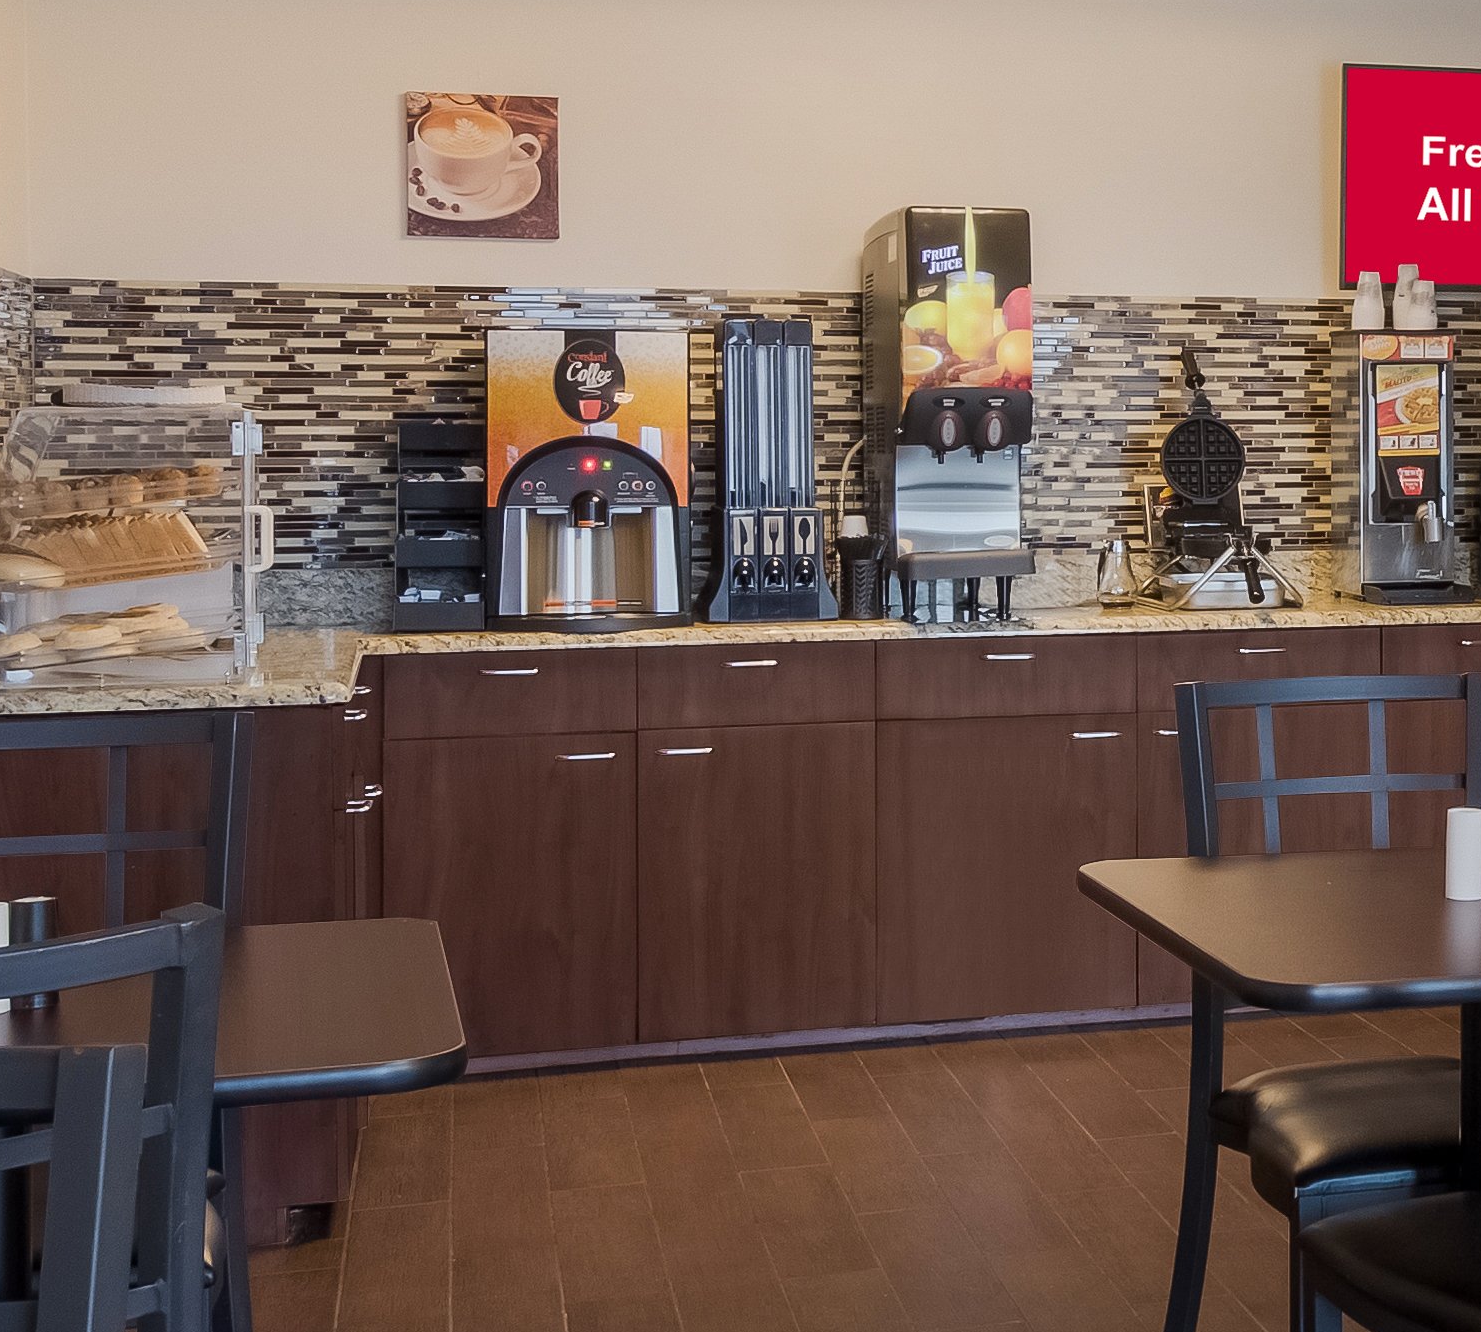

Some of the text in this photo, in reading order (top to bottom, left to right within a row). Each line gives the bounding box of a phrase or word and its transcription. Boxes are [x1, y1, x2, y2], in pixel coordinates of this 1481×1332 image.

[1417, 186, 1472, 222] All
[921, 245, 959, 263] FRUIT
[928, 257, 963, 274] JUICE
[566, 361, 613, 387] Coffee
